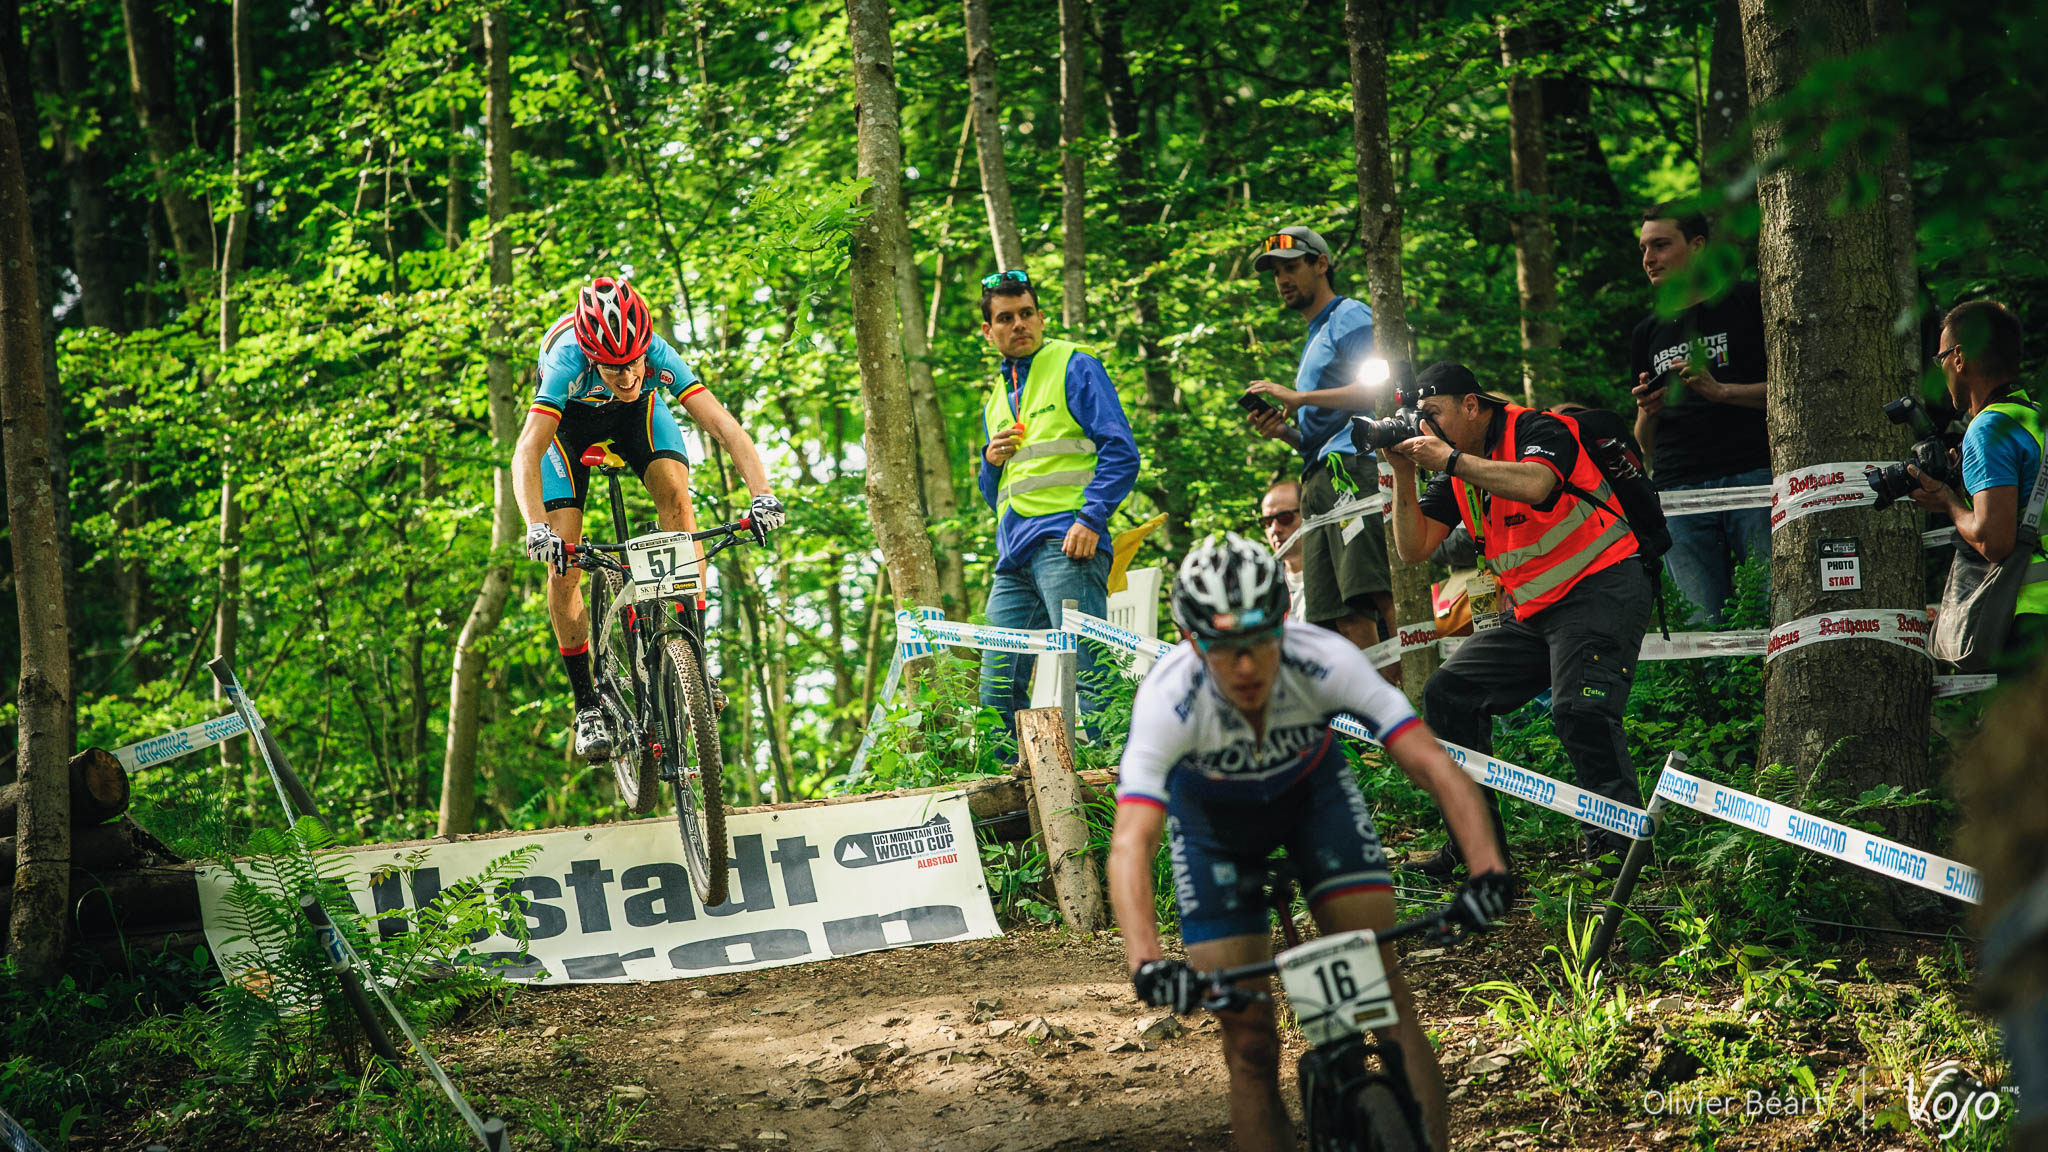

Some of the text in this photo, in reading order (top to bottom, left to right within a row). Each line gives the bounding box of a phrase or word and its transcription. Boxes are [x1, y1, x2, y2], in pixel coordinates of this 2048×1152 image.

[1788, 471, 1845, 496] Rothaus
[647, 546, 677, 578] 57
[1827, 560, 1854, 571] PHOTO
[1828, 576, 1855, 587] START
[1818, 617, 1881, 637] Rothaus
[1895, 613, 1929, 636] Rotha
[1483, 761, 1557, 805] SHIMANO
[1658, 770, 1699, 804] IMANO
[1575, 794, 1656, 838] SHIMANO
[1712, 790, 1772, 829] SHIMANO
[873, 823, 952, 846] UCI MOUNTAIN BIKE
[876, 840, 925, 860] WORLD
[928, 833, 954, 851] CUP
[1786, 815, 1848, 855] SHIMANO
[917, 853, 959, 869] ALBSTADT
[1864, 840, 1927, 882] SHIMANO
[1944, 866, 1984, 900] SHIM
[1314, 960, 1358, 1005] 16
